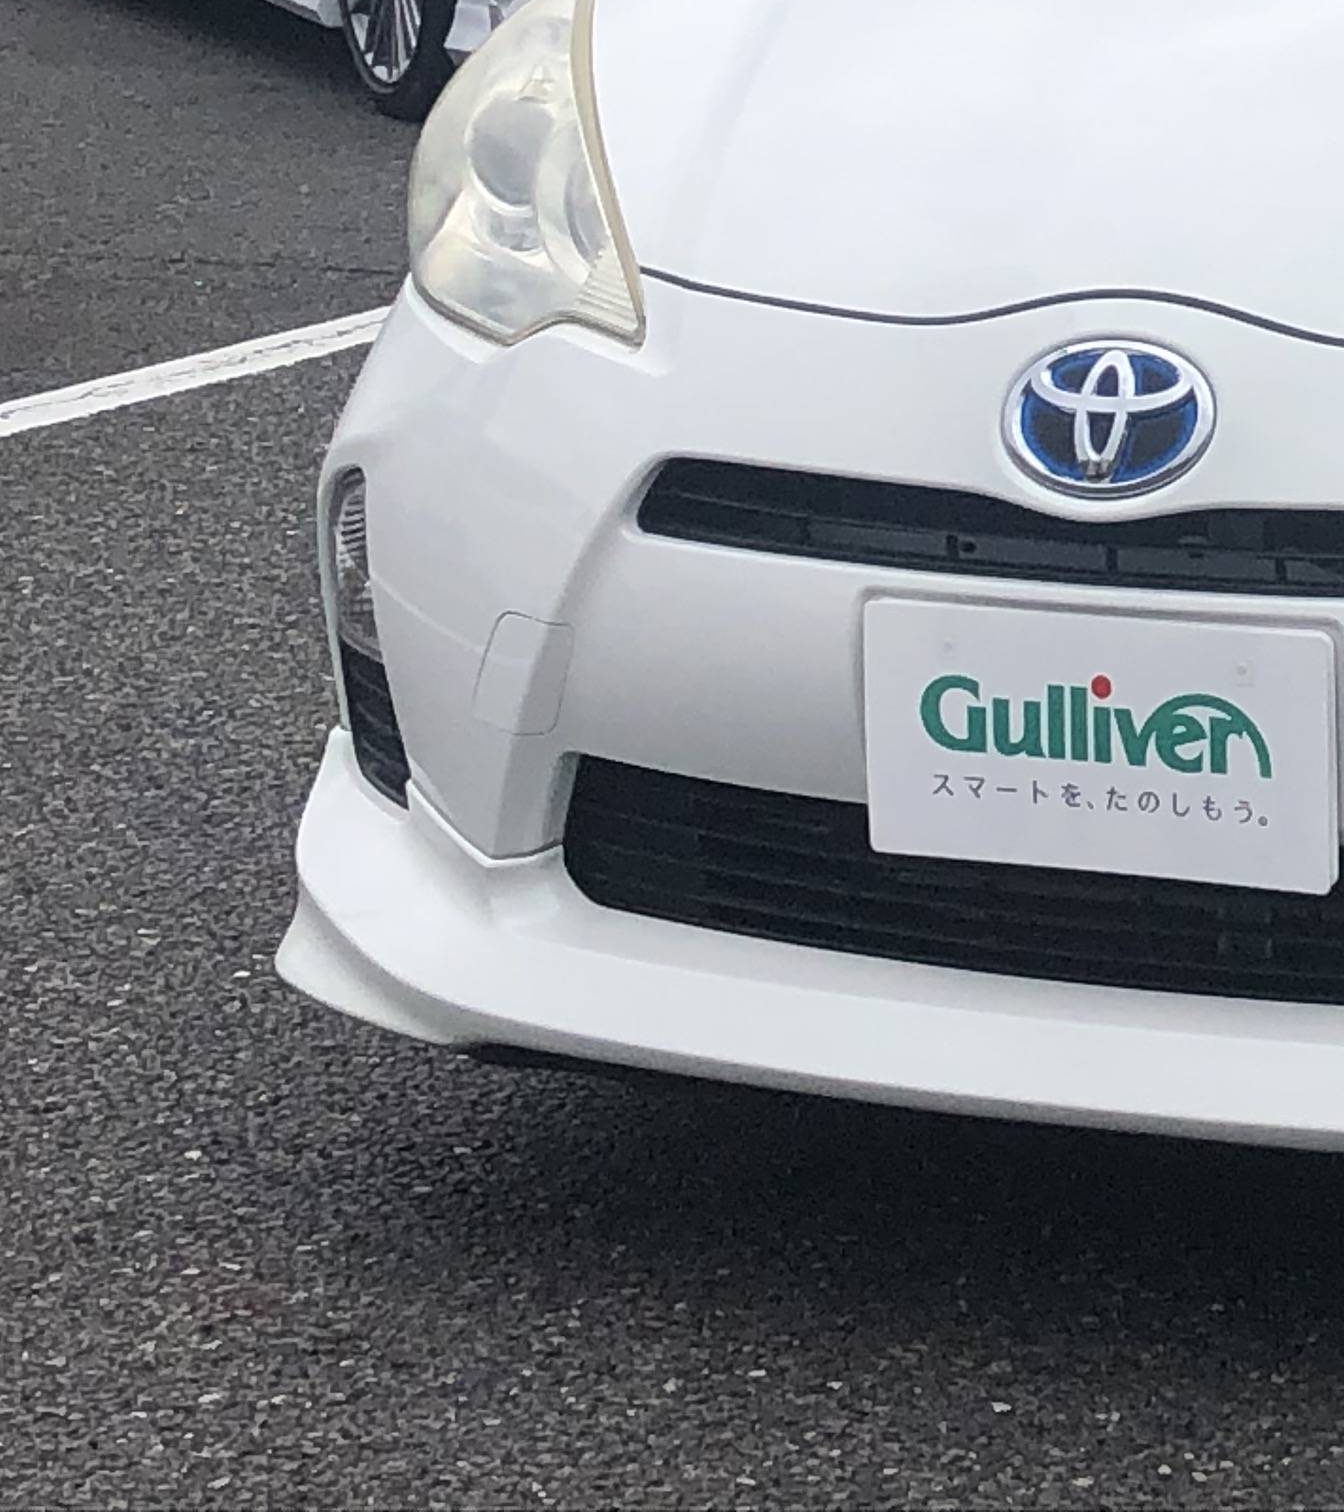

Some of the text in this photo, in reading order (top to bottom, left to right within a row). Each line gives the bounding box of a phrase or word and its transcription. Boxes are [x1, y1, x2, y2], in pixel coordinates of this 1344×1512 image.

[919, 674, 1272, 779] Gulliver
[931, 772, 1270, 827] スマートを、たのしもう。
